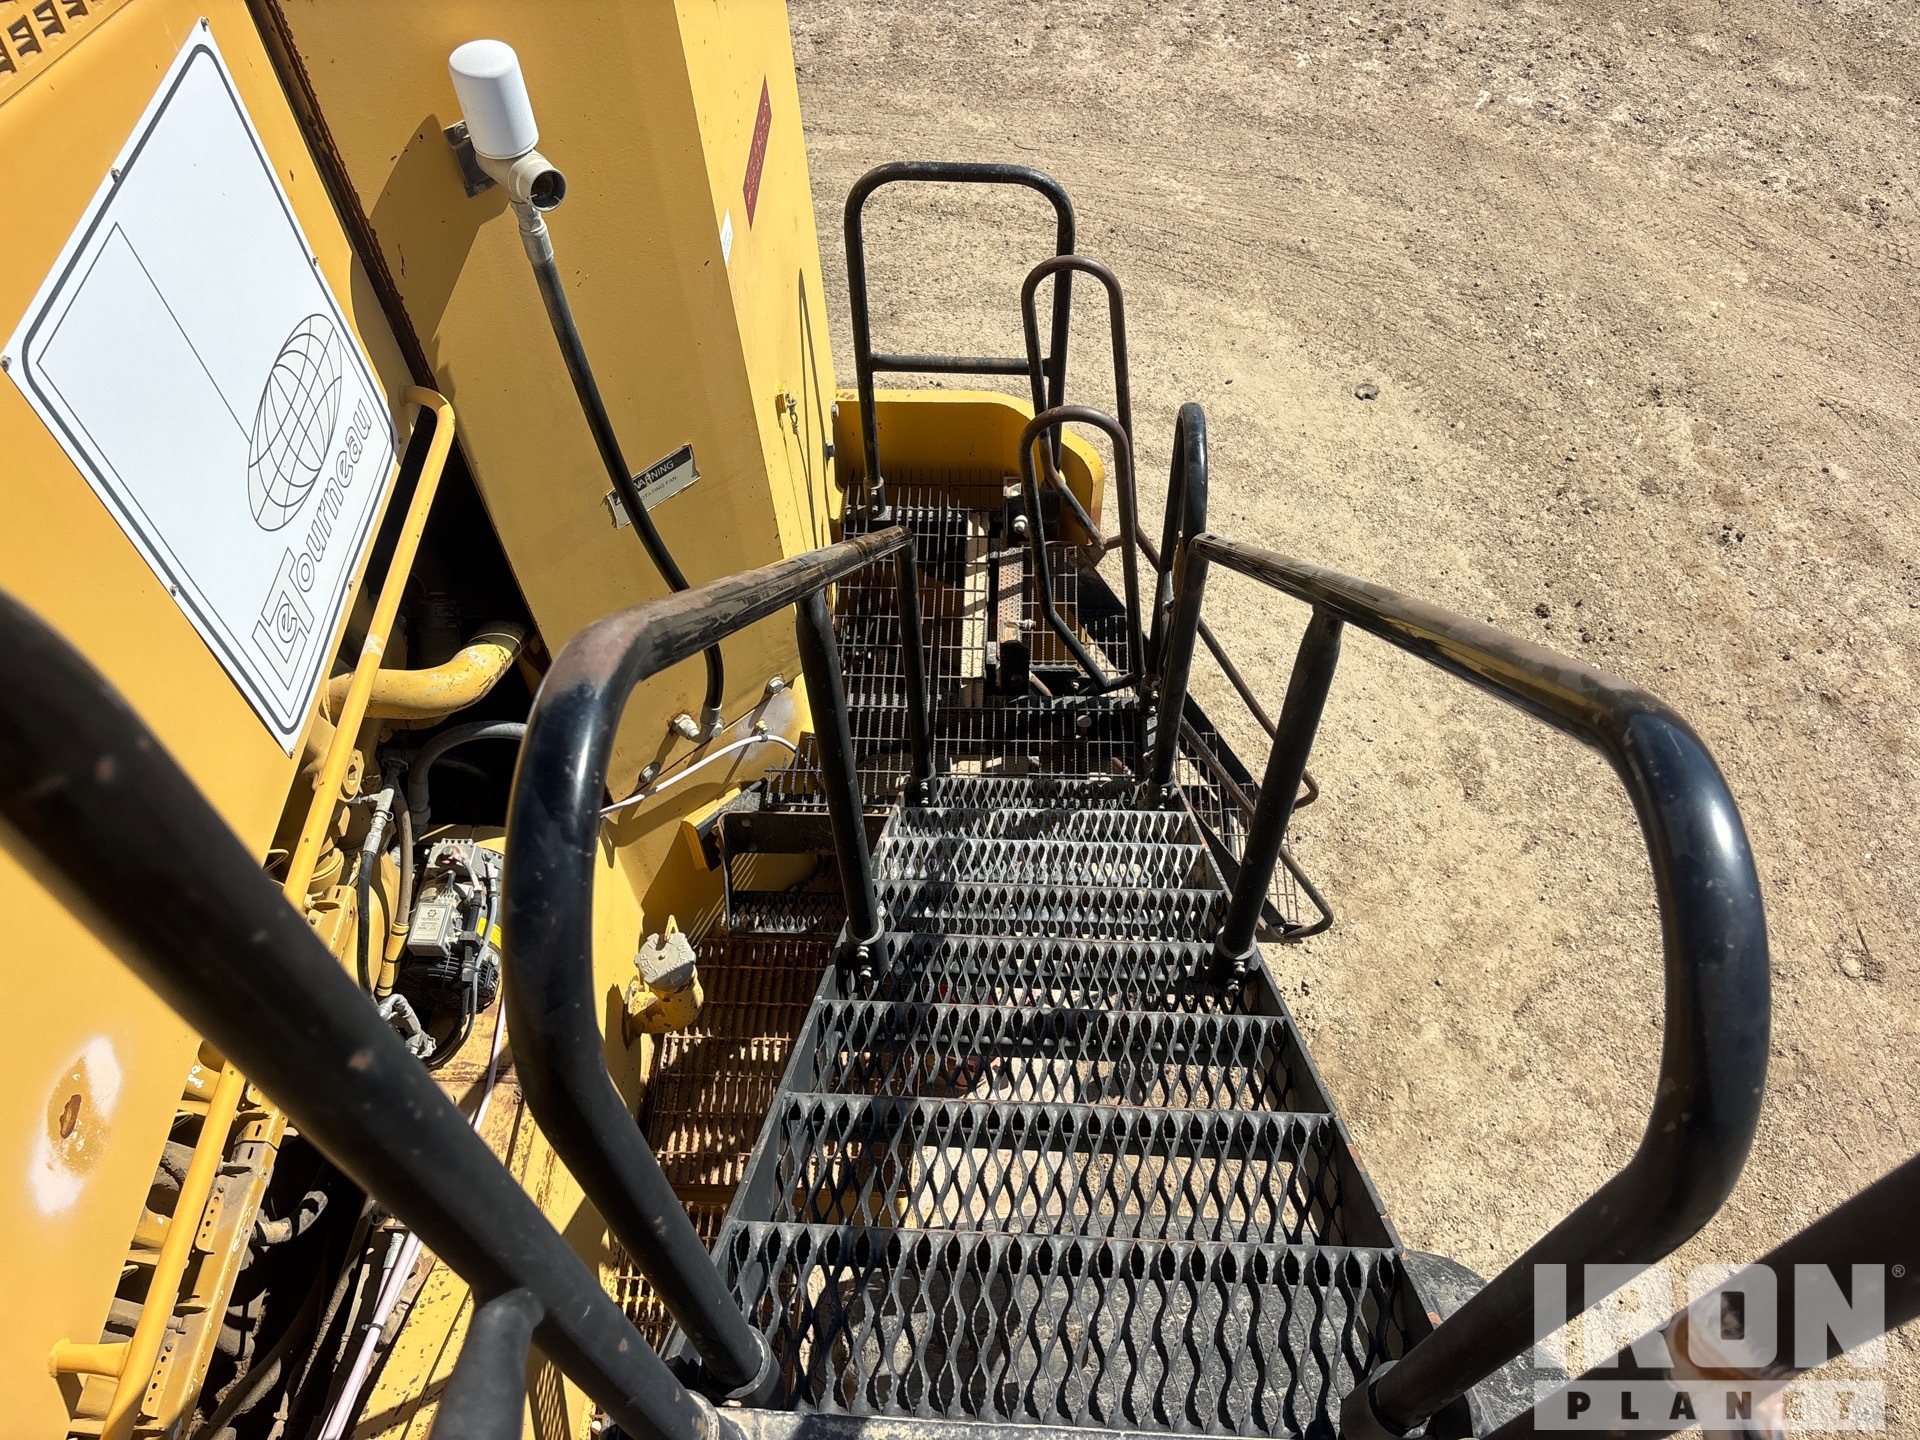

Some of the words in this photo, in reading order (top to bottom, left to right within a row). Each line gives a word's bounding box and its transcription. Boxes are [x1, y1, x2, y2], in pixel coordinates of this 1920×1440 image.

[251, 398, 373, 692] LeTourneau
[640, 484, 666, 501] OTATING
[665, 475, 678, 486] FAN
